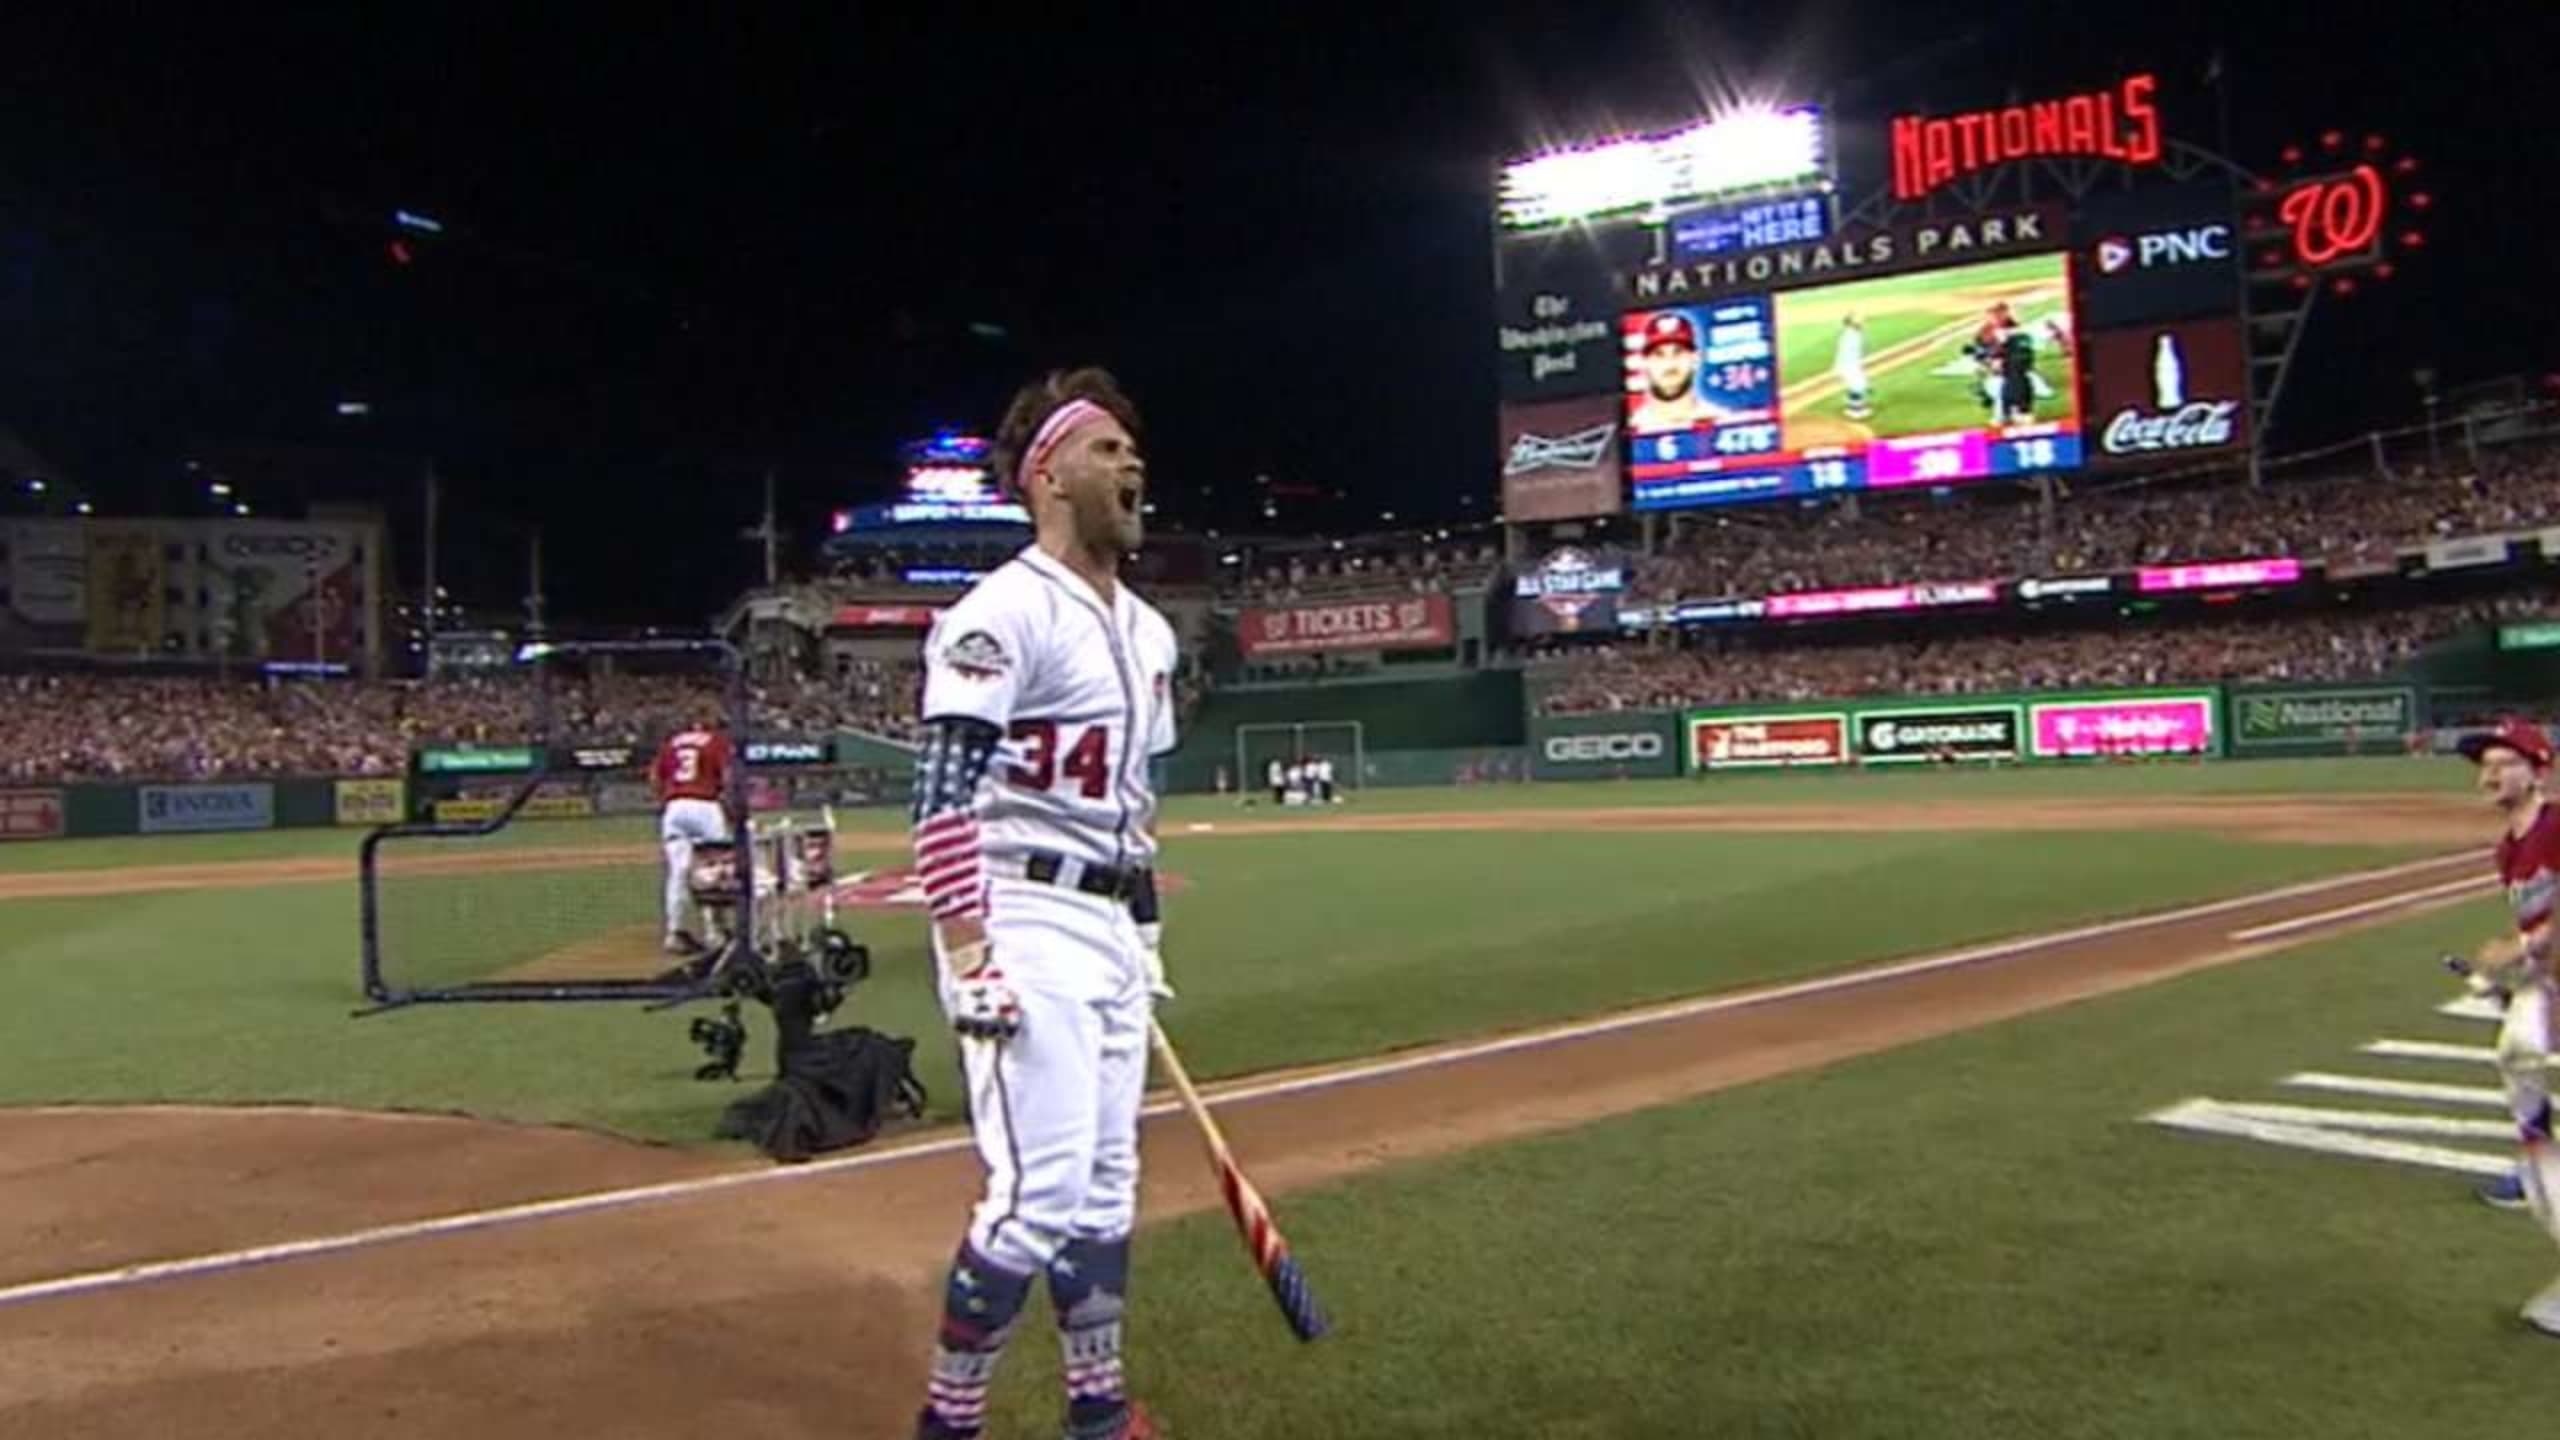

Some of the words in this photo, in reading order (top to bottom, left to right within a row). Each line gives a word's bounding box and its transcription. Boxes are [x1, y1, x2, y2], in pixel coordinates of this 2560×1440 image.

[1892, 75, 2159, 198] NATIONALS
[1743, 214, 1822, 247] HERE
[2280, 165, 2384, 262] W
[1635, 237, 1894, 296] NATIONALS
[1918, 214, 2041, 253] PARK
[2139, 227, 2230, 266] PNC
[1294, 604, 1391, 635] TICKETS
[674, 750, 698, 782] 3
[1005, 718, 1110, 800] 34
[1546, 733, 1662, 760] GEICO
